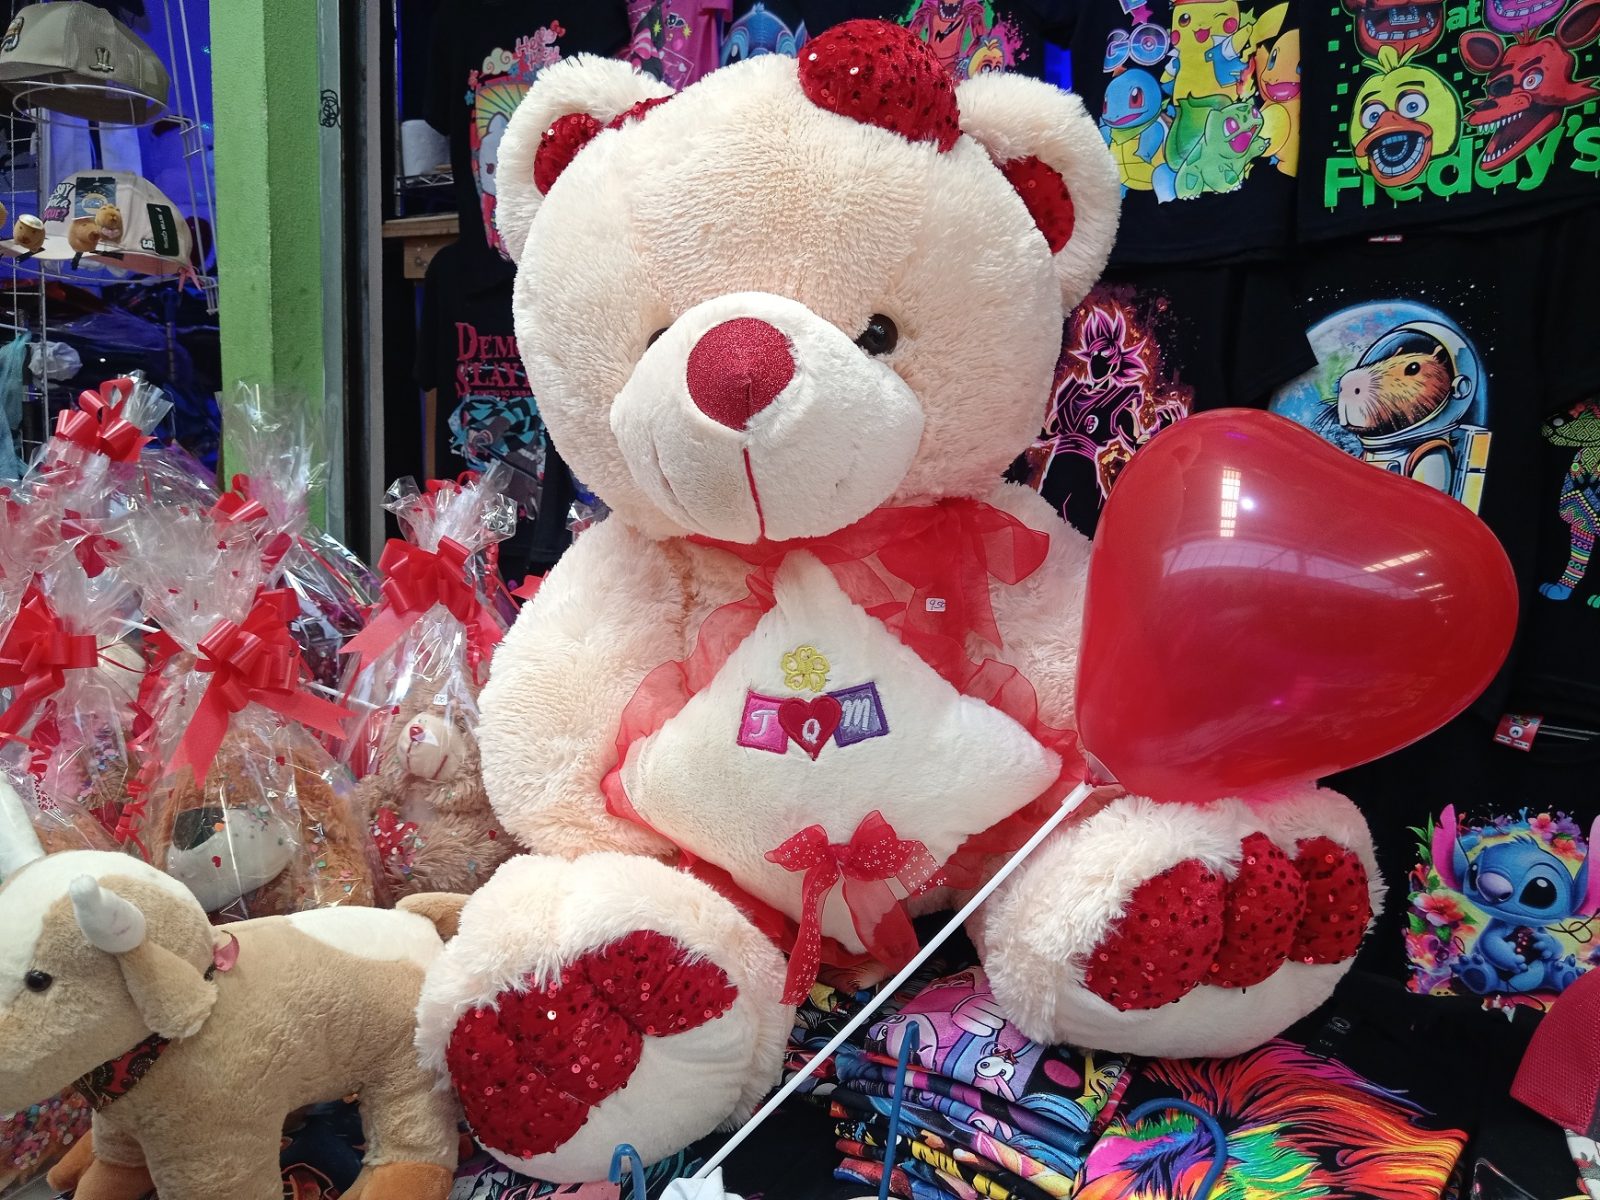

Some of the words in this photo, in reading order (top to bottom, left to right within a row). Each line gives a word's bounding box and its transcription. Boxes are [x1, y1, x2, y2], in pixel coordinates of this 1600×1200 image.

[1446, 0, 1481, 30] at
[1103, 23, 1171, 73] GO
[455, 322, 519, 361] DEM
